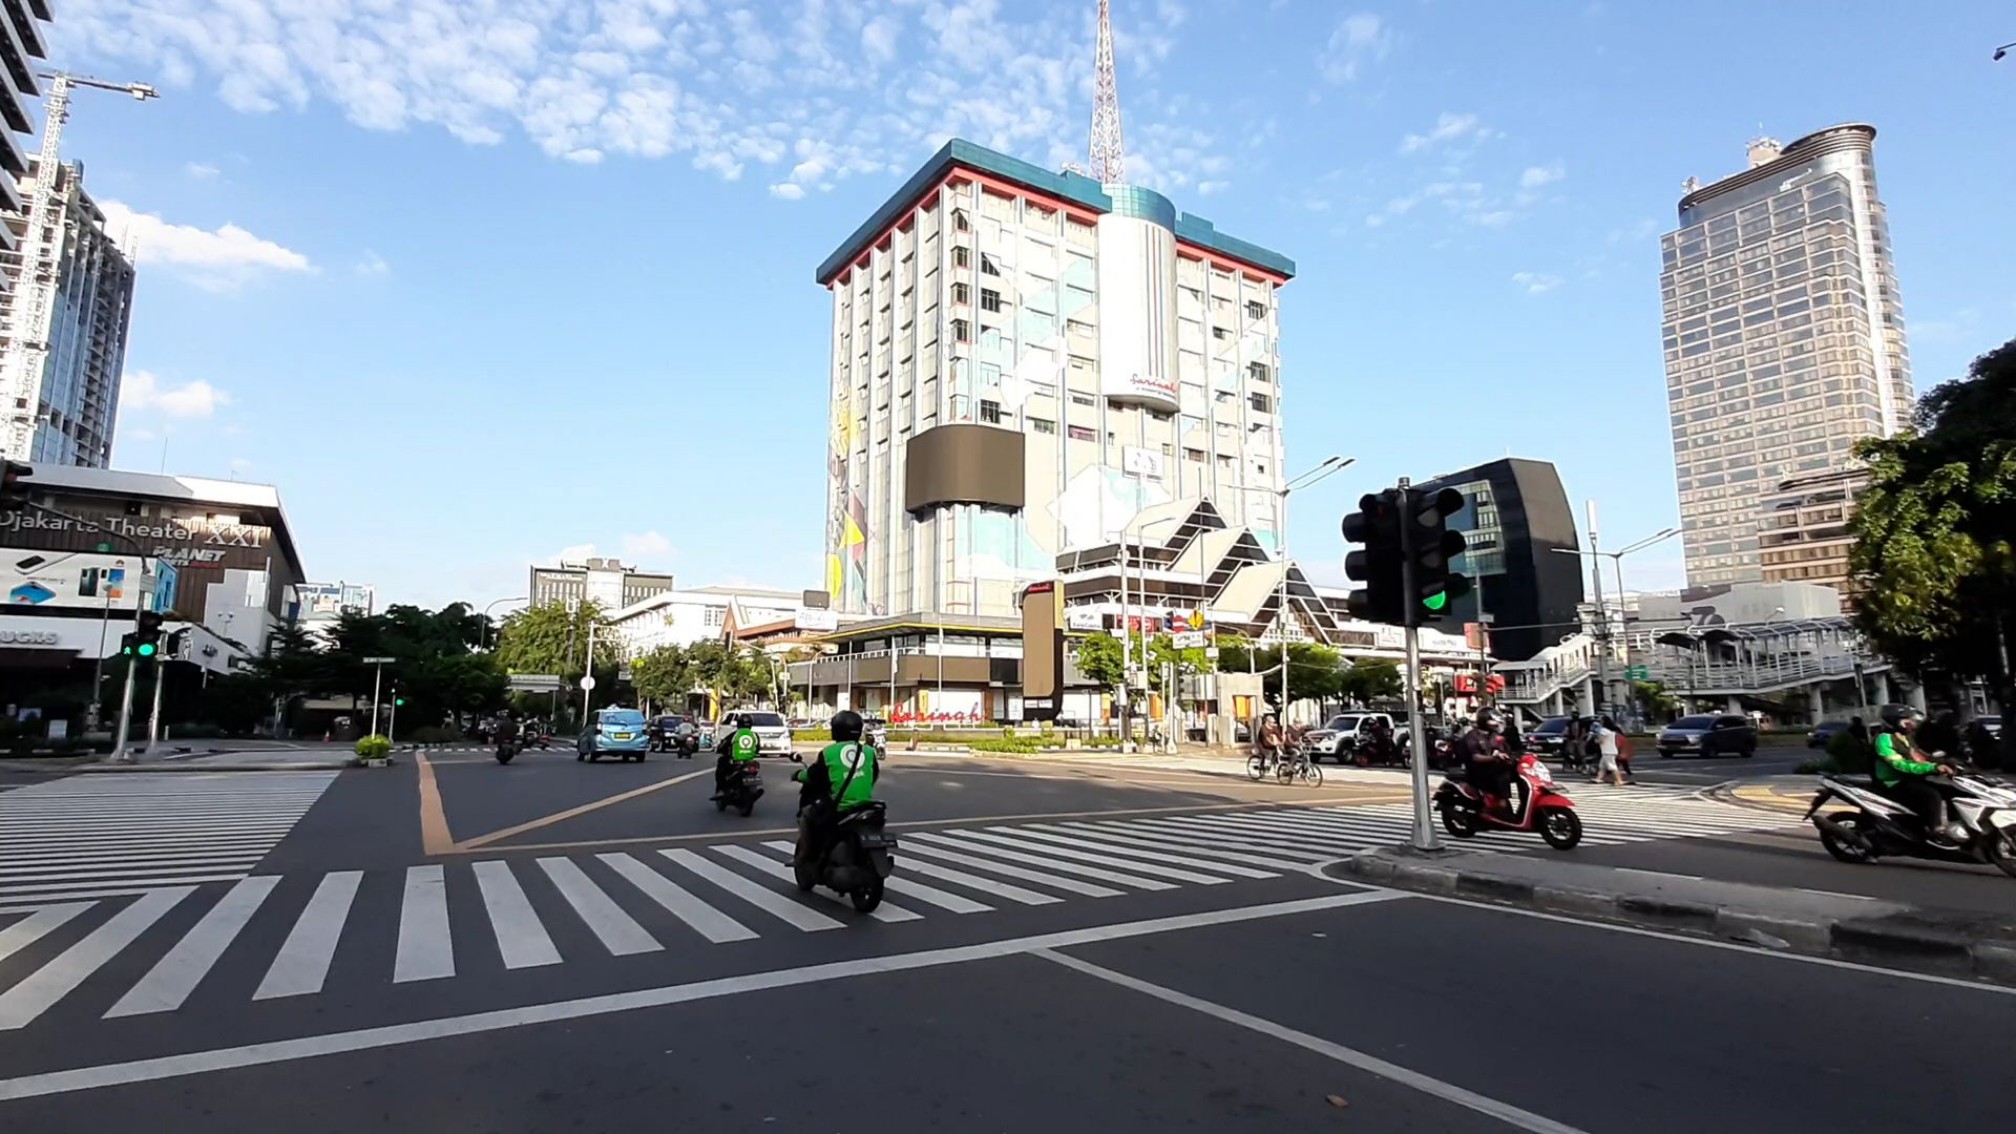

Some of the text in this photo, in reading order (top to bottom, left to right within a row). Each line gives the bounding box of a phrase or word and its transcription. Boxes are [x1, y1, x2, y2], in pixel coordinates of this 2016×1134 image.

[106, 517, 198, 541] Theater
[204, 523, 263, 548] XXI
[152, 545, 227, 562] PLANET
